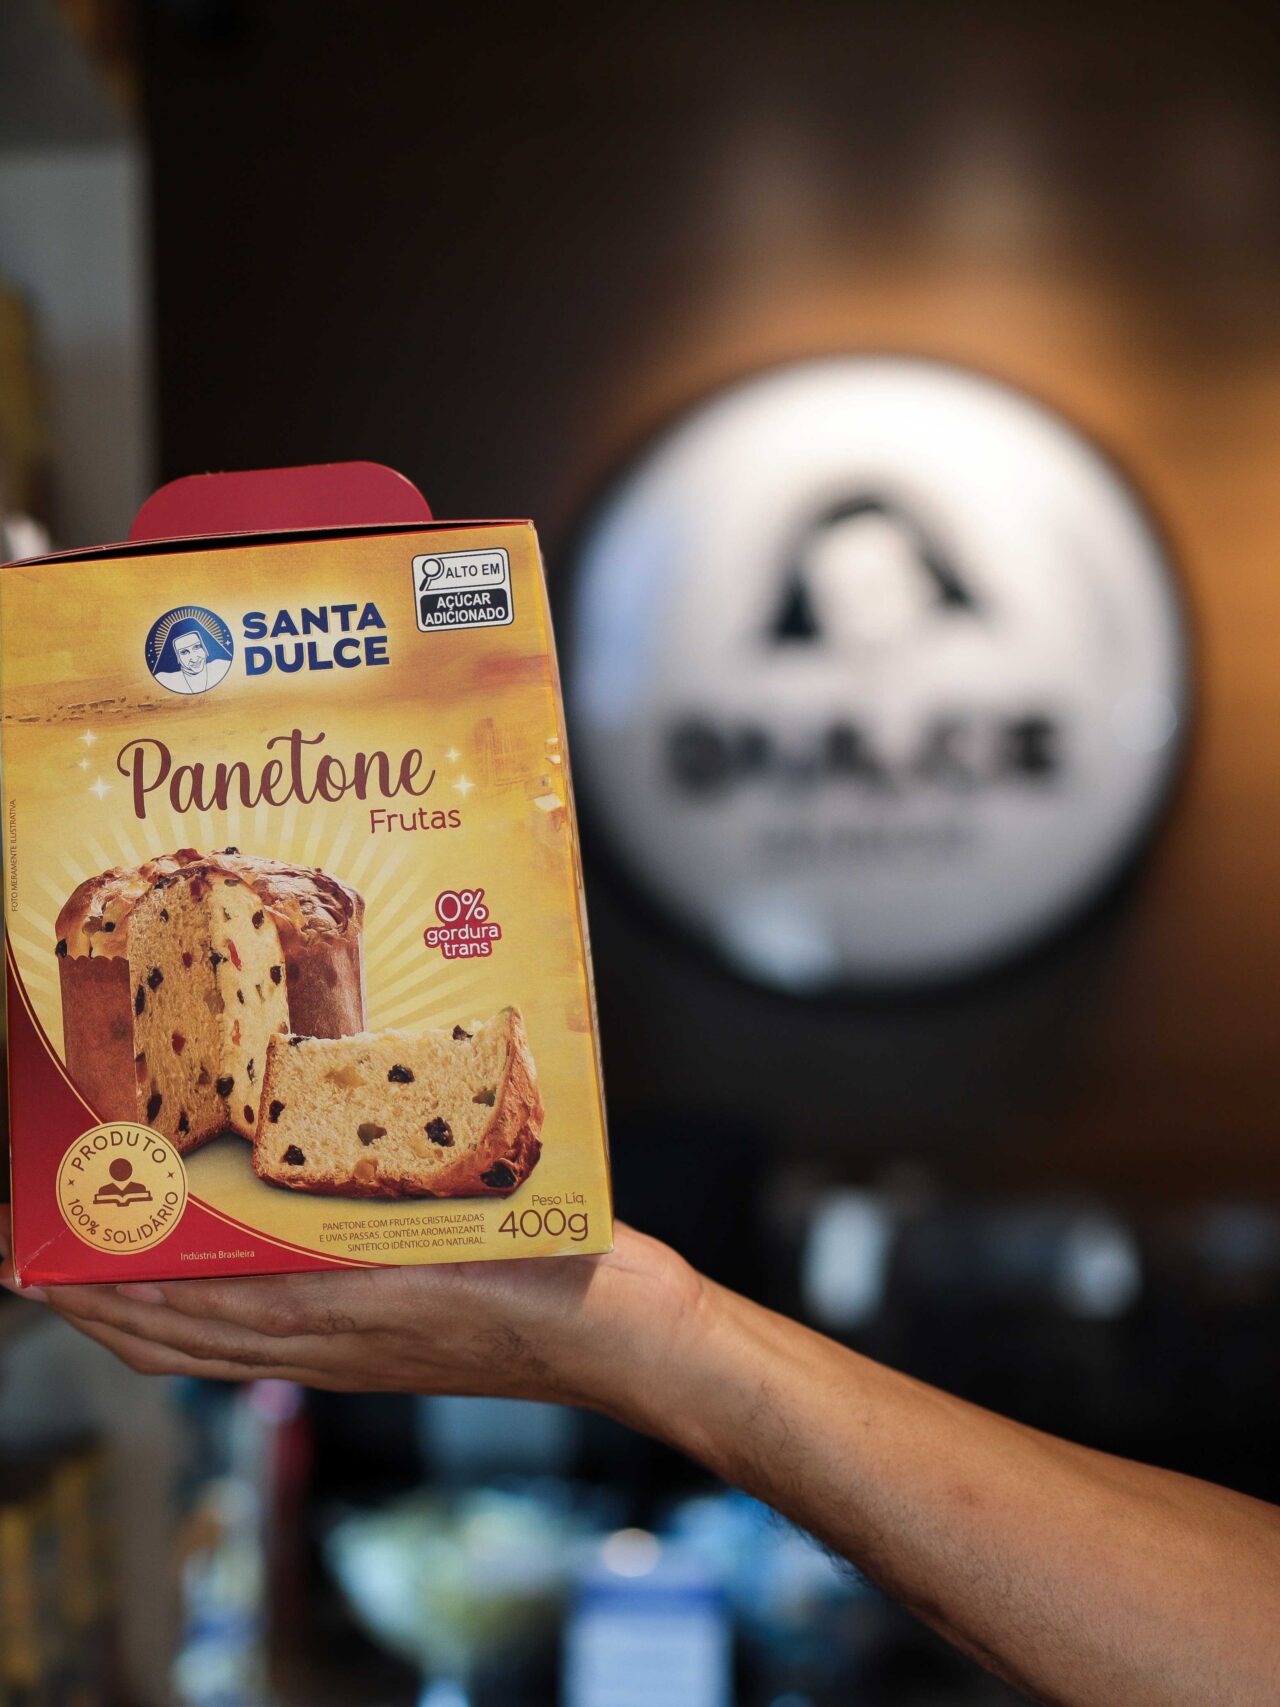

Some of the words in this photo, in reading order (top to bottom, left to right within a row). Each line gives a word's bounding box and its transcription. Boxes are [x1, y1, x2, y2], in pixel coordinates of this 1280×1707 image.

[446, 565, 478, 579] ALTO
[482, 563, 500, 576] EM
[437, 592, 491, 610] AÇÚCAR
[242, 602, 387, 640] SANTA
[425, 607, 505, 625] ADICIONADO
[244, 635, 390, 676] DULCE
[117, 728, 436, 820] Panetone
[369, 807, 462, 834] Frutas
[10, 845, 18, 891] MERAMENTE
[11, 892, 19, 912] FOTO
[438, 891, 486, 922] 0%
[426, 924, 499, 945] gordura
[444, 942, 489, 956] trans
[71, 1131, 167, 1172] PRODUTO
[531, 1194, 562, 1206] Peso
[565, 1192, 587, 1205] Líq.
[68, 1199, 100, 1235] 100%
[102, 1191, 178, 1244] SOLIDÁRIO
[322, 1221, 367, 1231] PANETONE
[368, 1219, 388, 1228] COM
[389, 1217, 420, 1226] FRUTAS
[421, 1213, 485, 1225] CRISTALIZADAS
[498, 1208, 588, 1241] 400g
[319, 1234, 325, 1243] E
[326, 1232, 348, 1242] UVAS
[349, 1230, 381, 1241] PASSAS.
[383, 1227, 419, 1239] CONTÉM
[420, 1225, 486, 1237] AROMATIZANTE
[180, 1251, 217, 1261] Indústria
[218, 1249, 255, 1259] Brasileira
[347, 1241, 390, 1252] SINTÉTICO
[391, 1238, 430, 1249] IDÊNTICO
[432, 1238, 445, 1247] AO
